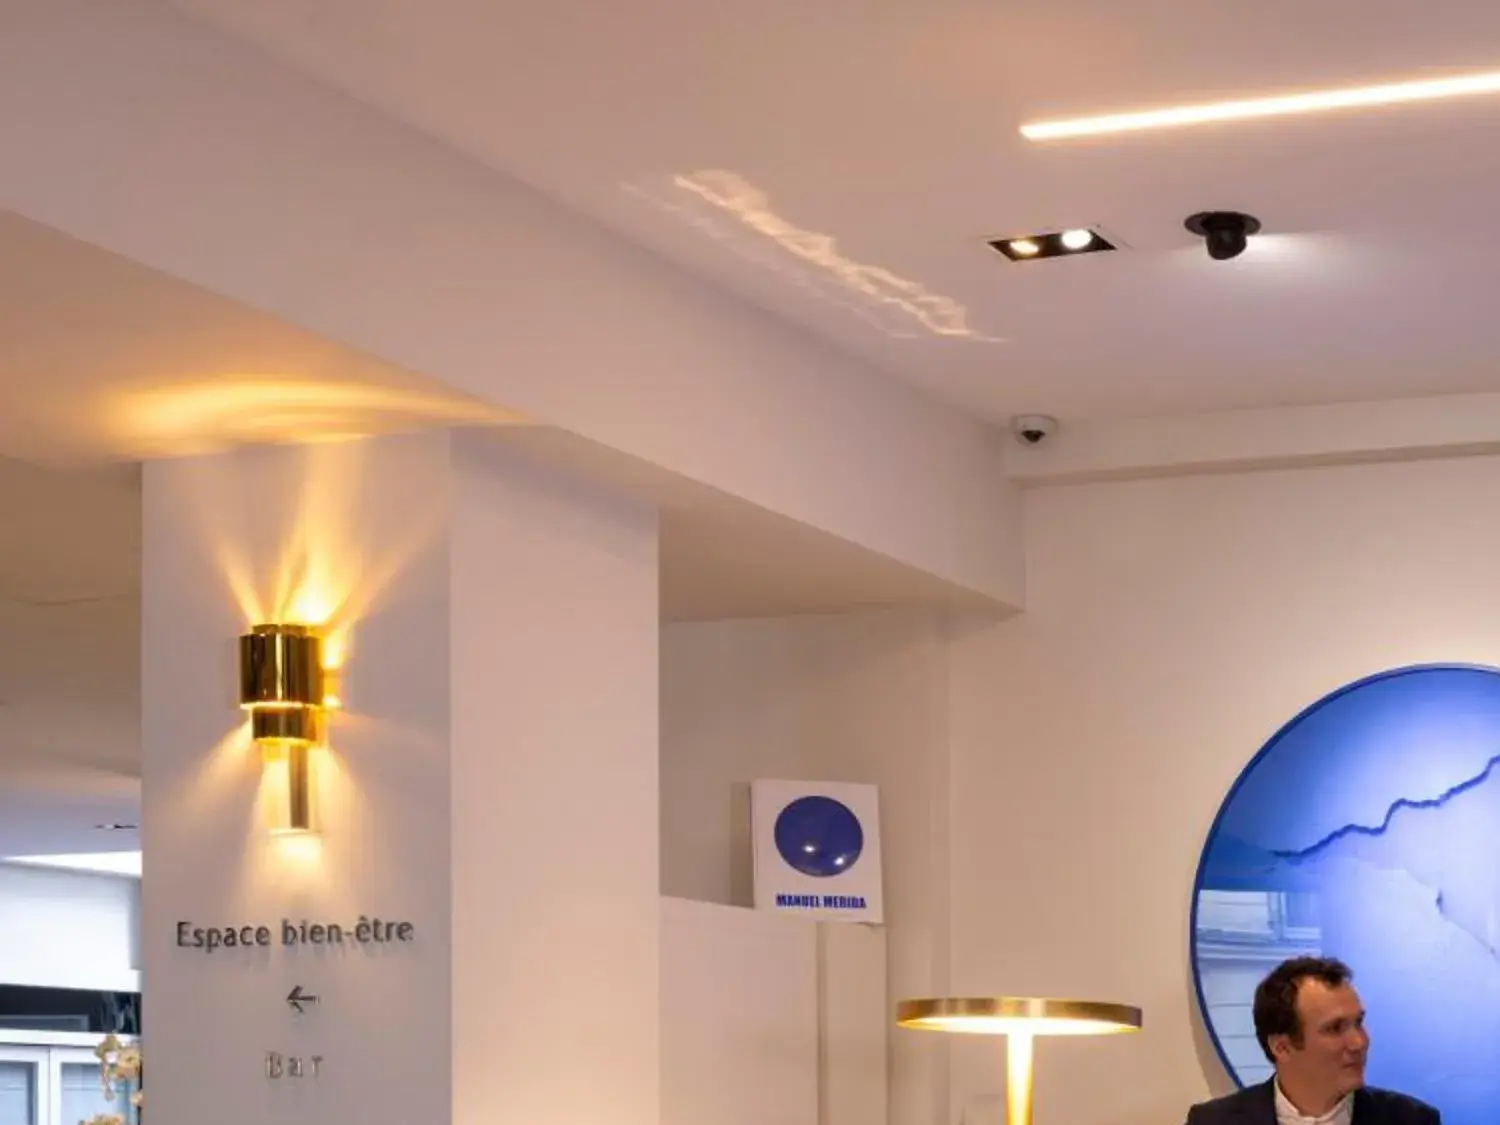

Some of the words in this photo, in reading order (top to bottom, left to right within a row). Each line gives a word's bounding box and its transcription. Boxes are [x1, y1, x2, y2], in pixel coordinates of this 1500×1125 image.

[776, 894, 819, 908] MANUEL
[176, 920, 270, 953] Espace
[281, 915, 414, 947] bien-être
[265, 1052, 323, 1080] Bar
